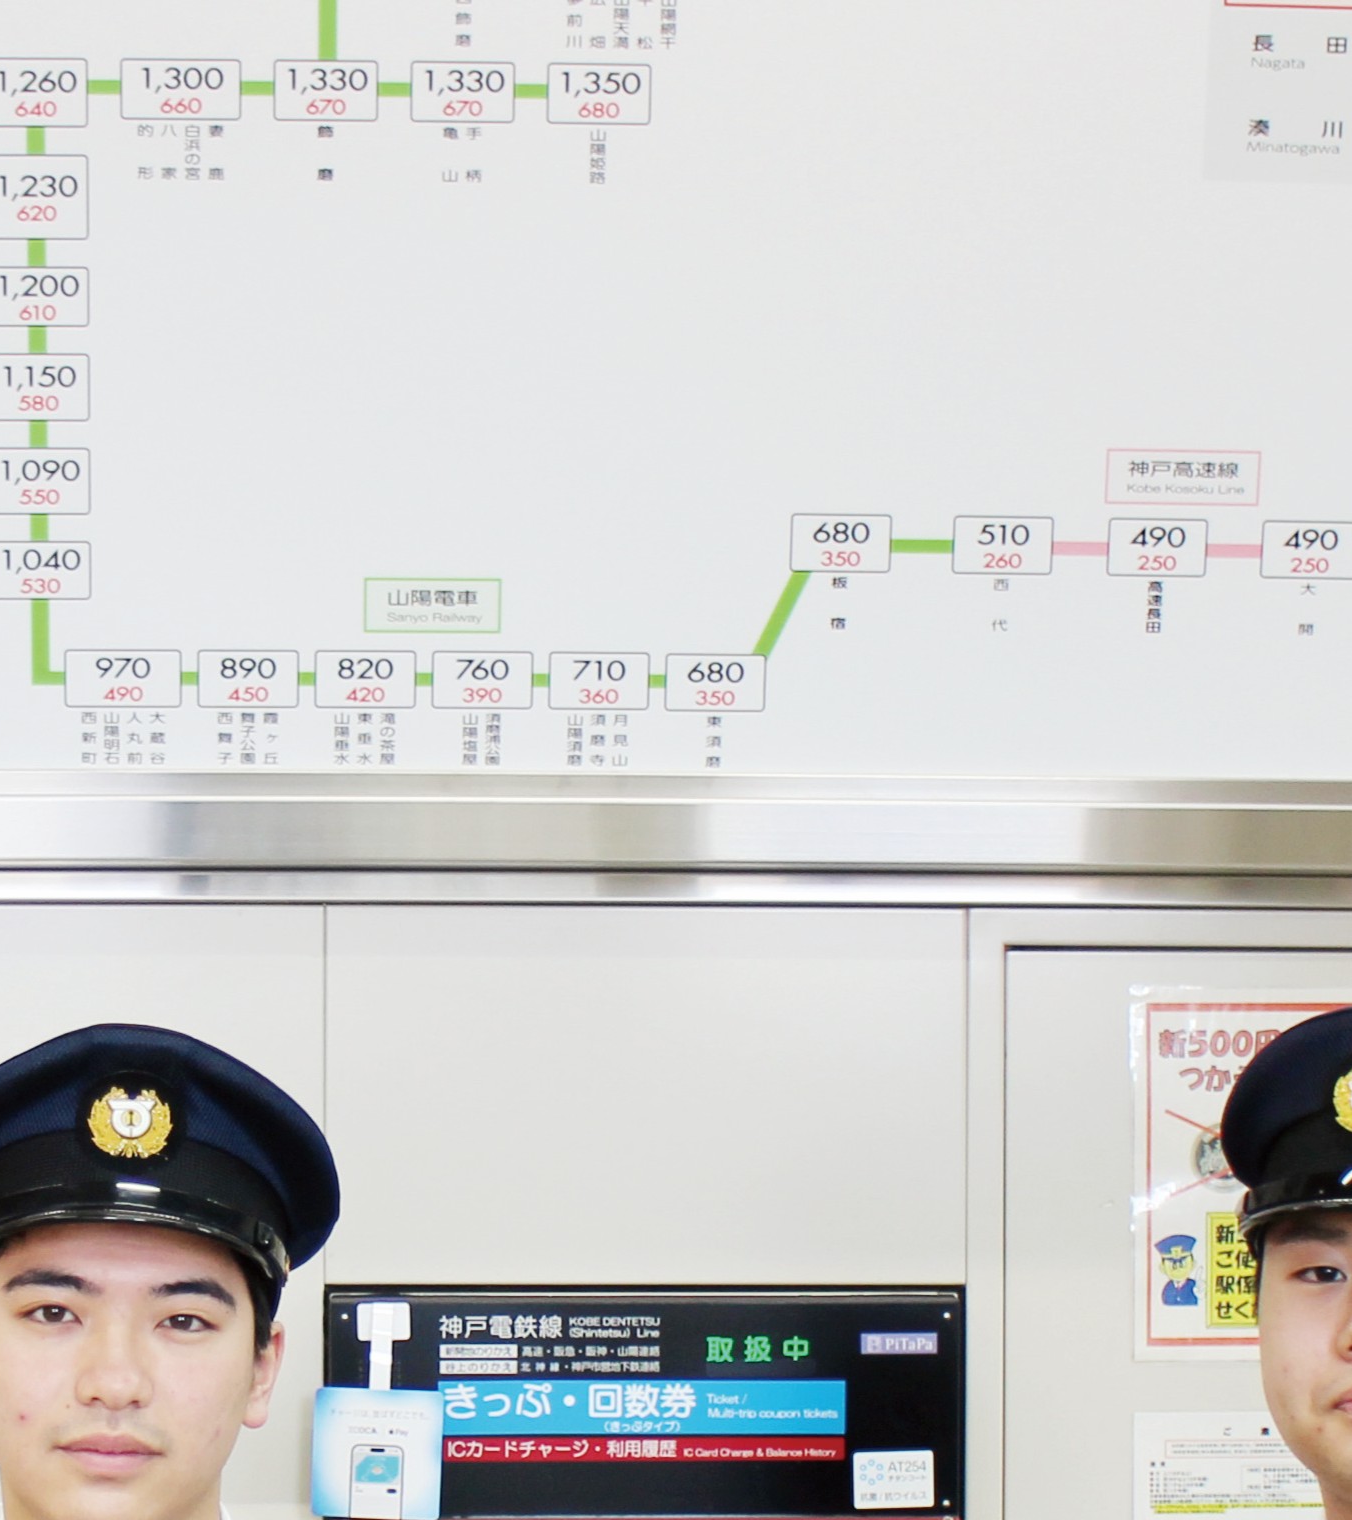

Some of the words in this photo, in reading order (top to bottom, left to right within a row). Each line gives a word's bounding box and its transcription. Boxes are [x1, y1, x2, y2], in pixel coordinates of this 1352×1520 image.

[1253, 34, 1348, 54] 長田
[1250, 57, 1306, 71] Nagata
[143, 67, 223, 92] 1,300
[289, 68, 368, 94] 1,330
[426, 70, 505, 95] 1,330
[562, 72, 641, 96] 1,350
[1246, 141, 1341, 156] Minatogawa
[0, 175, 78, 200] 1,230
[0, 275, 79, 300] 1,200
[4, 366, 76, 390] 1,150
[2, 460, 80, 484] 1,090
[1129, 461, 1239, 479] 神戸高速線
[1126, 483, 1162, 494] Kobe
[1218, 483, 1244, 494] Line
[813, 522, 870, 544] 680
[978, 524, 1029, 546] 510
[1131, 527, 1186, 548] 490
[1284, 529, 1338, 550] 490
[3, 549, 80, 573] 1,040
[388, 590, 477, 606] 山陽電車
[387, 613, 429, 623] Sanyo
[433, 613, 483, 624] Railway
[96, 658, 150, 679] 970
[221, 658, 276, 679] 890
[338, 658, 393, 679] 820
[457, 659, 509, 680] 760
[574, 660, 626, 681] 710
[688, 662, 744, 683] 680
[82, 712, 96, 762] 西新町
[104, 712, 119, 763] 山陽明石
[128, 712, 142, 763] 人丸前
[612, 714, 628, 766] 月見山
[439, 1315, 563, 1339] 神戸電鉄線
[569, 1317, 601, 1326] KOBE
[602, 1317, 661, 1326] DENTETSU
[569, 1327, 631, 1339] (Shintetsu)
[636, 1328, 660, 1338] Line
[706, 1335, 809, 1363] 取扱中
[885, 1338, 933, 1351] PiTaPa
[443, 1383, 697, 1419] きっぷ・回数券
[706, 1393, 739, 1404] Ticket
[758, 1409, 801, 1420] coupon
[803, 1408, 839, 1419] tickets
[448, 1439, 678, 1459] ICカードチャージ・利用履歴
[888, 1461, 927, 1472] AT254
